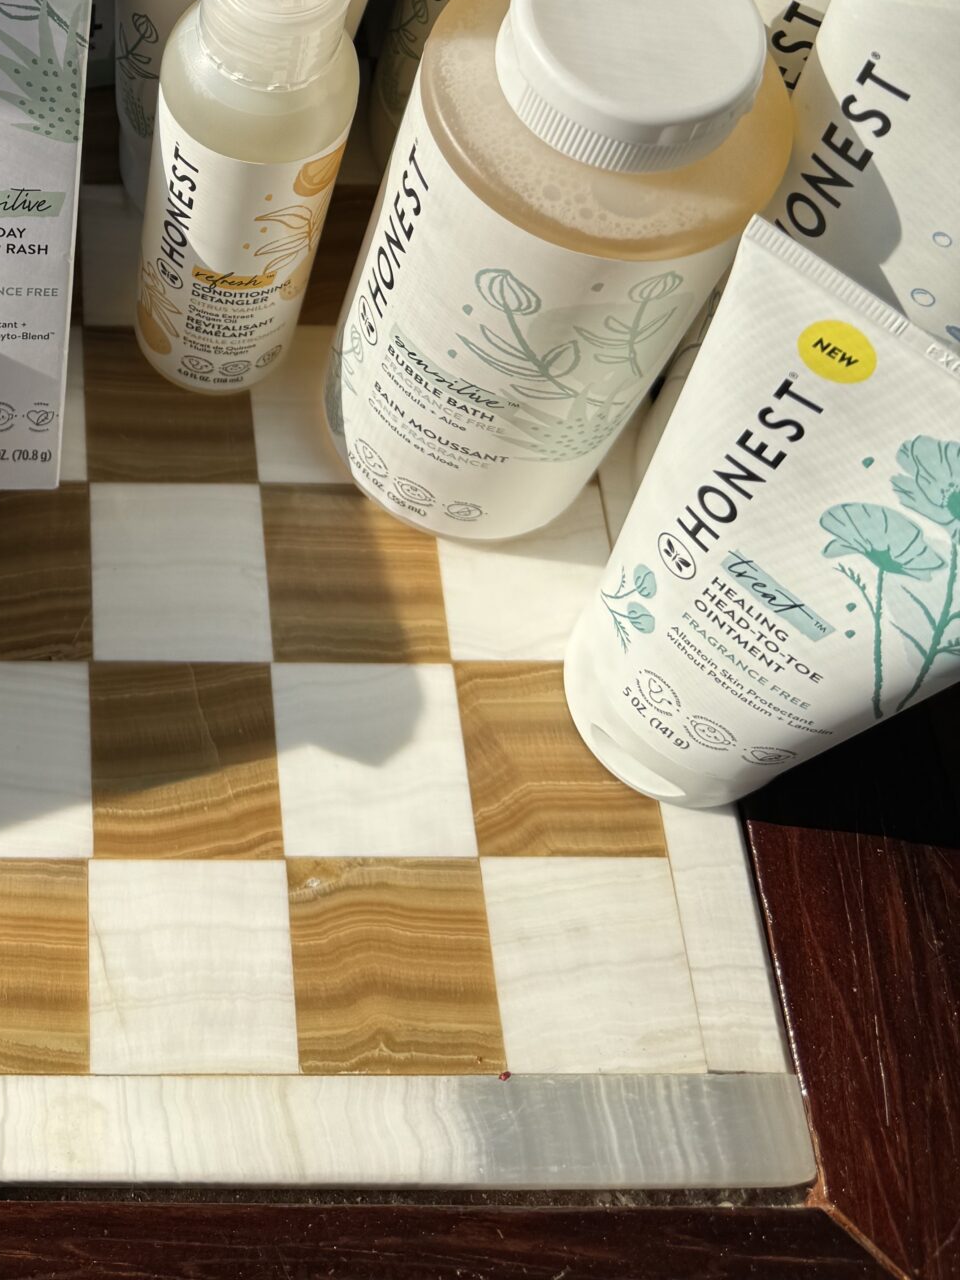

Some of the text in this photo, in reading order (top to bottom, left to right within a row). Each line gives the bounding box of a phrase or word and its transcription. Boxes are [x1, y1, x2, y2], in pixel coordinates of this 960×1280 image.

[6, 243, 48, 255] RASH
[26, 287, 59, 297] FREE
[191, 289, 269, 306] DETANGLER
[192, 280, 291, 298] CONDITIONING
[186, 315, 275, 331] REVITALISANT
[812, 337, 860, 369] NEW
[381, 363, 426, 410] Calendula
[439, 416, 467, 432] Aloe
[384, 354, 508, 434] FRAGRANCE FREE
[387, 344, 496, 422] BUBBLE BATH
[368, 398, 411, 444] Calendula
[374, 381, 406, 419] BAIN
[408, 418, 509, 463] MOUSSANT
[12, 449, 38, 462] (70.8
[40, 449, 52, 462] g)
[694, 599, 786, 673] OINTMENT
[702, 588, 824, 684] HEAD-TO-TOE
[711, 576, 789, 642] HEALING
[666, 632, 706, 671] without
[707, 670, 772, 717] Petrolatum
[787, 720, 834, 735] Lanolin
[671, 626, 718, 670] Allantoin
[719, 669, 744, 690] Skin
[746, 688, 815, 726] Protectant
[682, 612, 811, 710] FRAGRANCE FREE
[622, 686, 631, 697] 5
[631, 697, 647, 718] OZ.
[649, 717, 674, 739] (141
[674, 737, 690, 750] g)
